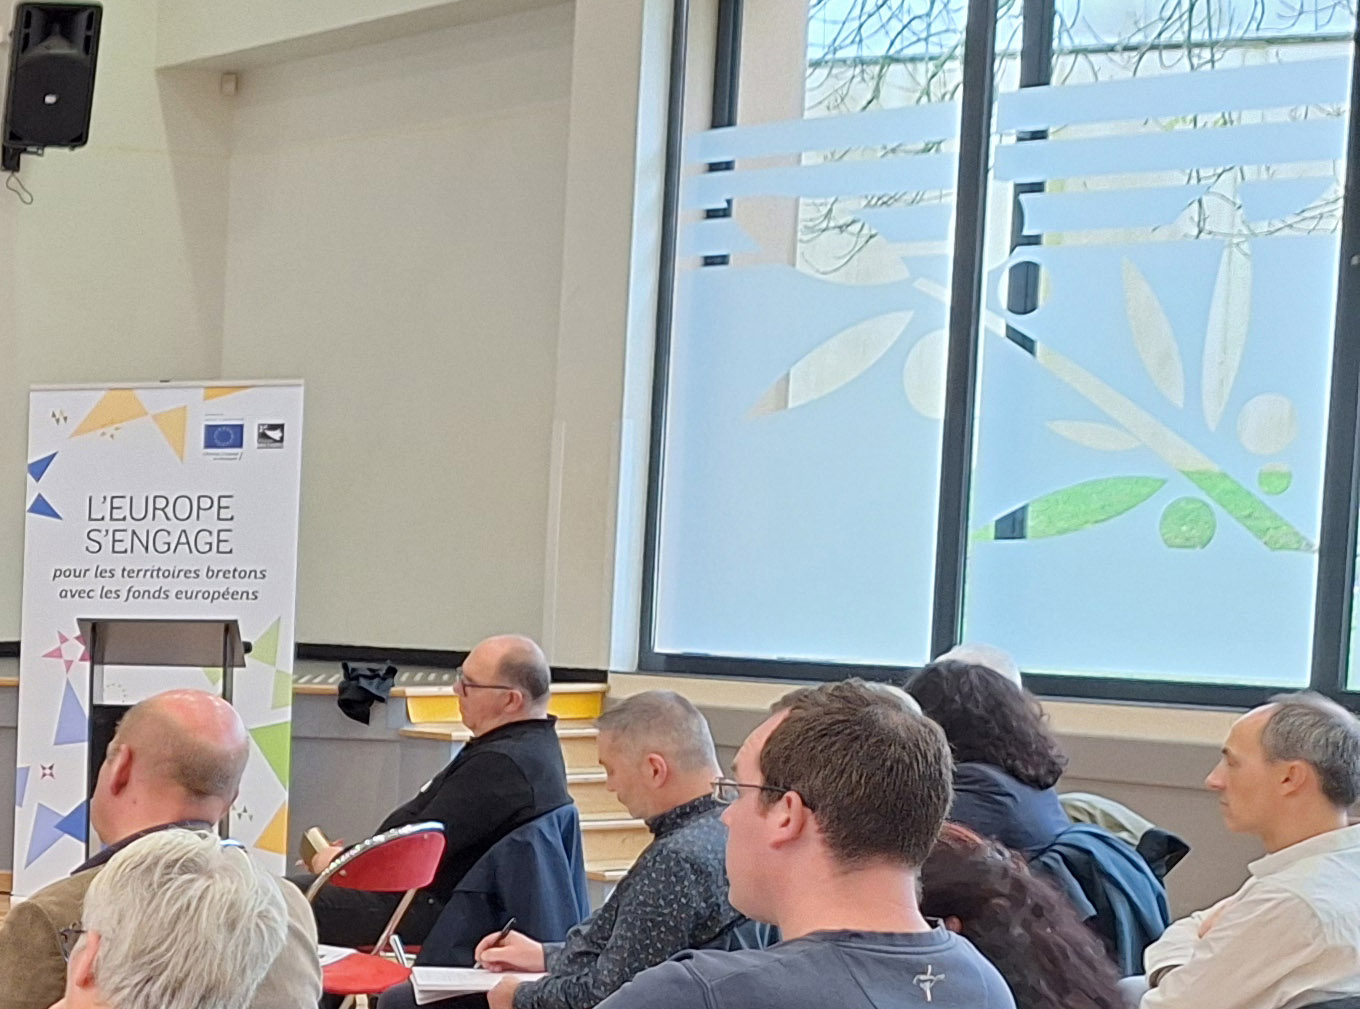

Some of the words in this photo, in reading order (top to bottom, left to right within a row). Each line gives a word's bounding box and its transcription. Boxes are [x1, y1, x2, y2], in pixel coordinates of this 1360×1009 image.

[87, 494, 235, 522] L'EUROPE
[85, 528, 234, 555] S'ENGAGE
[52, 567, 90, 581] pour
[94, 565, 116, 579] les
[121, 565, 200, 579] territoires
[205, 565, 267, 580] bretons
[59, 588, 95, 600] avec
[99, 586, 121, 600] les
[124, 585, 170, 603] fonds
[175, 586, 259, 603] européens
